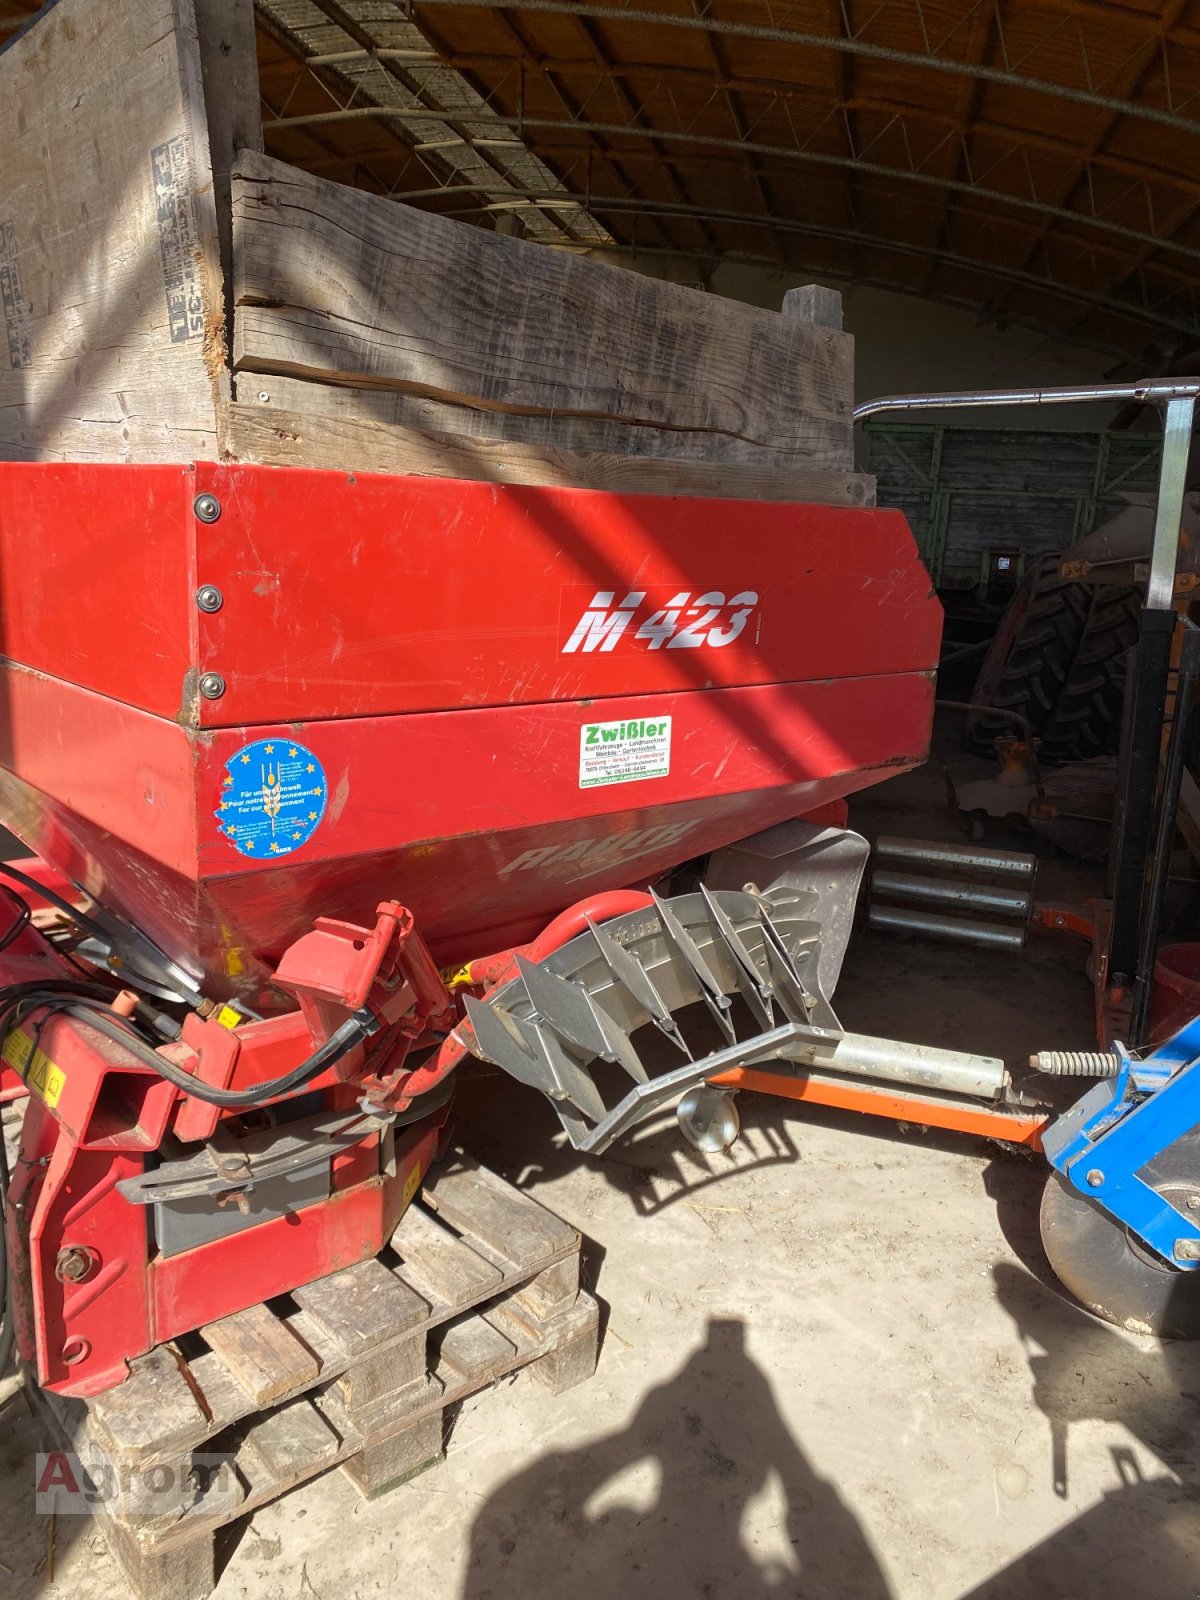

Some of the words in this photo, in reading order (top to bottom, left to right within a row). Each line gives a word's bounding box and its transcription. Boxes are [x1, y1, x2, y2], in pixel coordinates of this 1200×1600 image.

[561, 592, 646, 653] M
[634, 591, 759, 650] 423
[586, 721, 667, 744] Zwißler
[240, 789, 252, 798] Für
[228, 800, 245, 808] Pour
[238, 805, 251, 813] For
